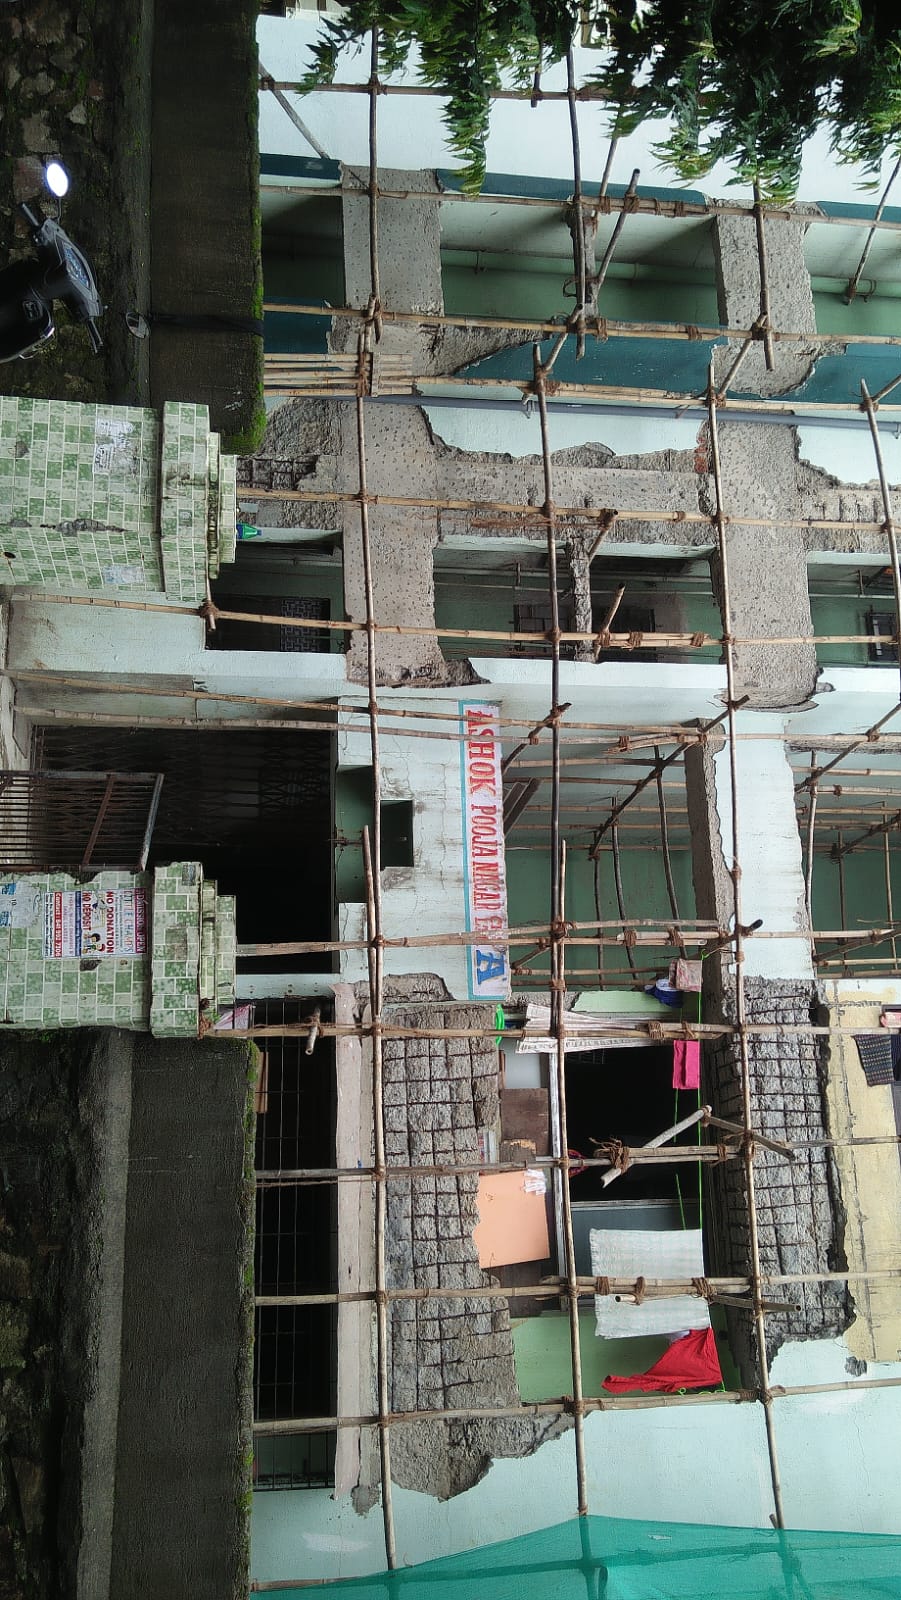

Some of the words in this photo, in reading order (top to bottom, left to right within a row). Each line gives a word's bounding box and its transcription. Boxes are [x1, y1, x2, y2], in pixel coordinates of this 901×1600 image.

[468, 710, 496, 797] ASHOK
[471, 804, 499, 858] POOJA
[82, 892, 91, 902] NO
[106, 892, 114, 904] NO
[472, 862, 502, 911] NAGAR
[82, 904, 91, 931] DEPOSIT
[124, 890, 134, 916] LITTLE
[106, 906, 114, 954] DONATION
[124, 919, 134, 953] CHAMPS
[136, 932, 146, 952] OPEN
